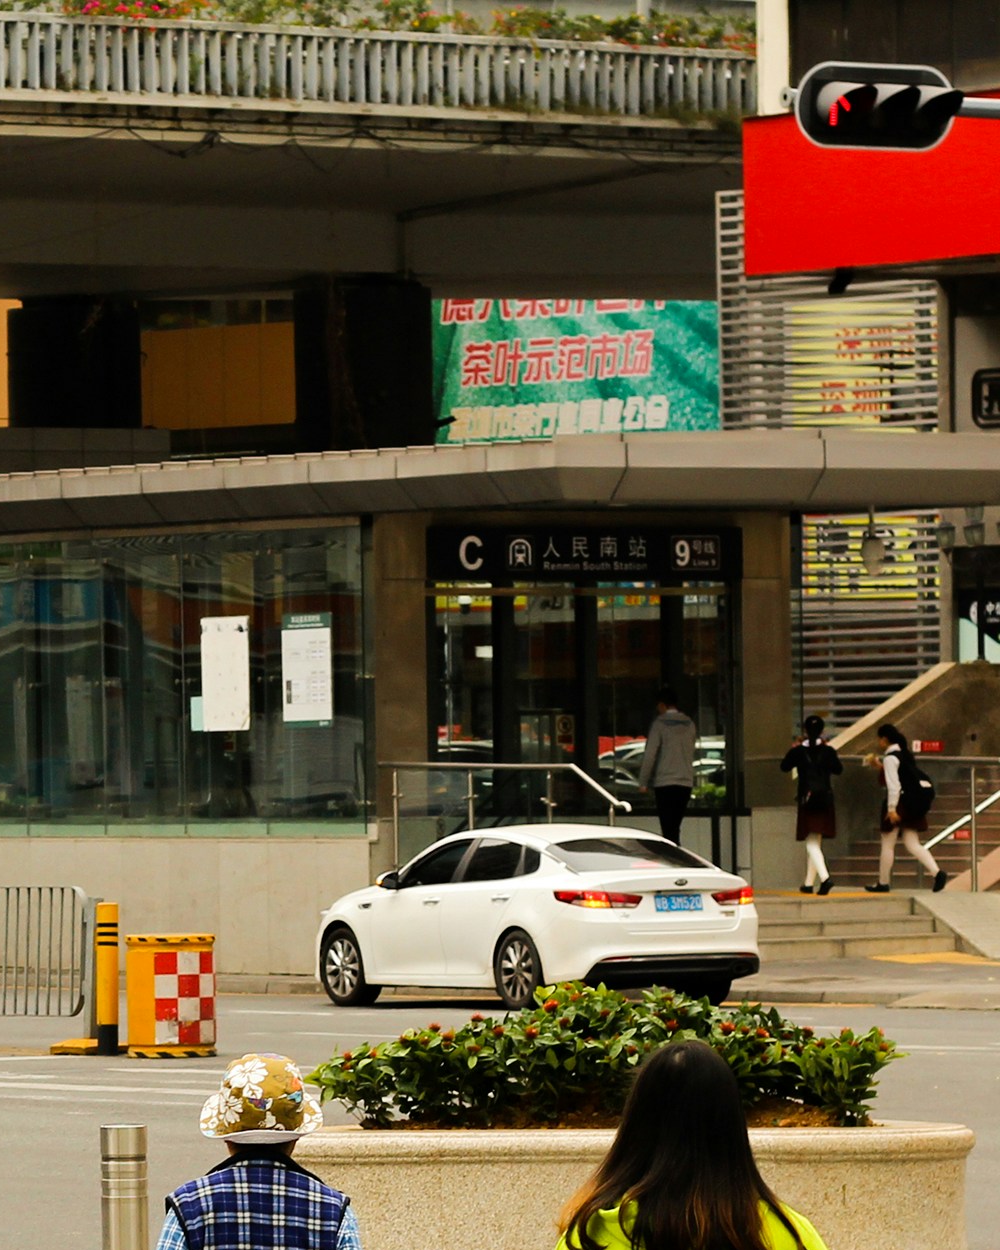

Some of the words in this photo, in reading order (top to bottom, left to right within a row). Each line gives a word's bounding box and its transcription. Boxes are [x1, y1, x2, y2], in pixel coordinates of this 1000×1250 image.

[461, 330, 654, 386] 茶叶示范市场
[459, 535, 483, 570] C
[542, 536, 647, 559] 人民南站
[675, 540, 690, 567] 9
[543, 561, 580, 571] Renmin
[583, 561, 612, 571] South
[613, 561, 648, 571] Station
